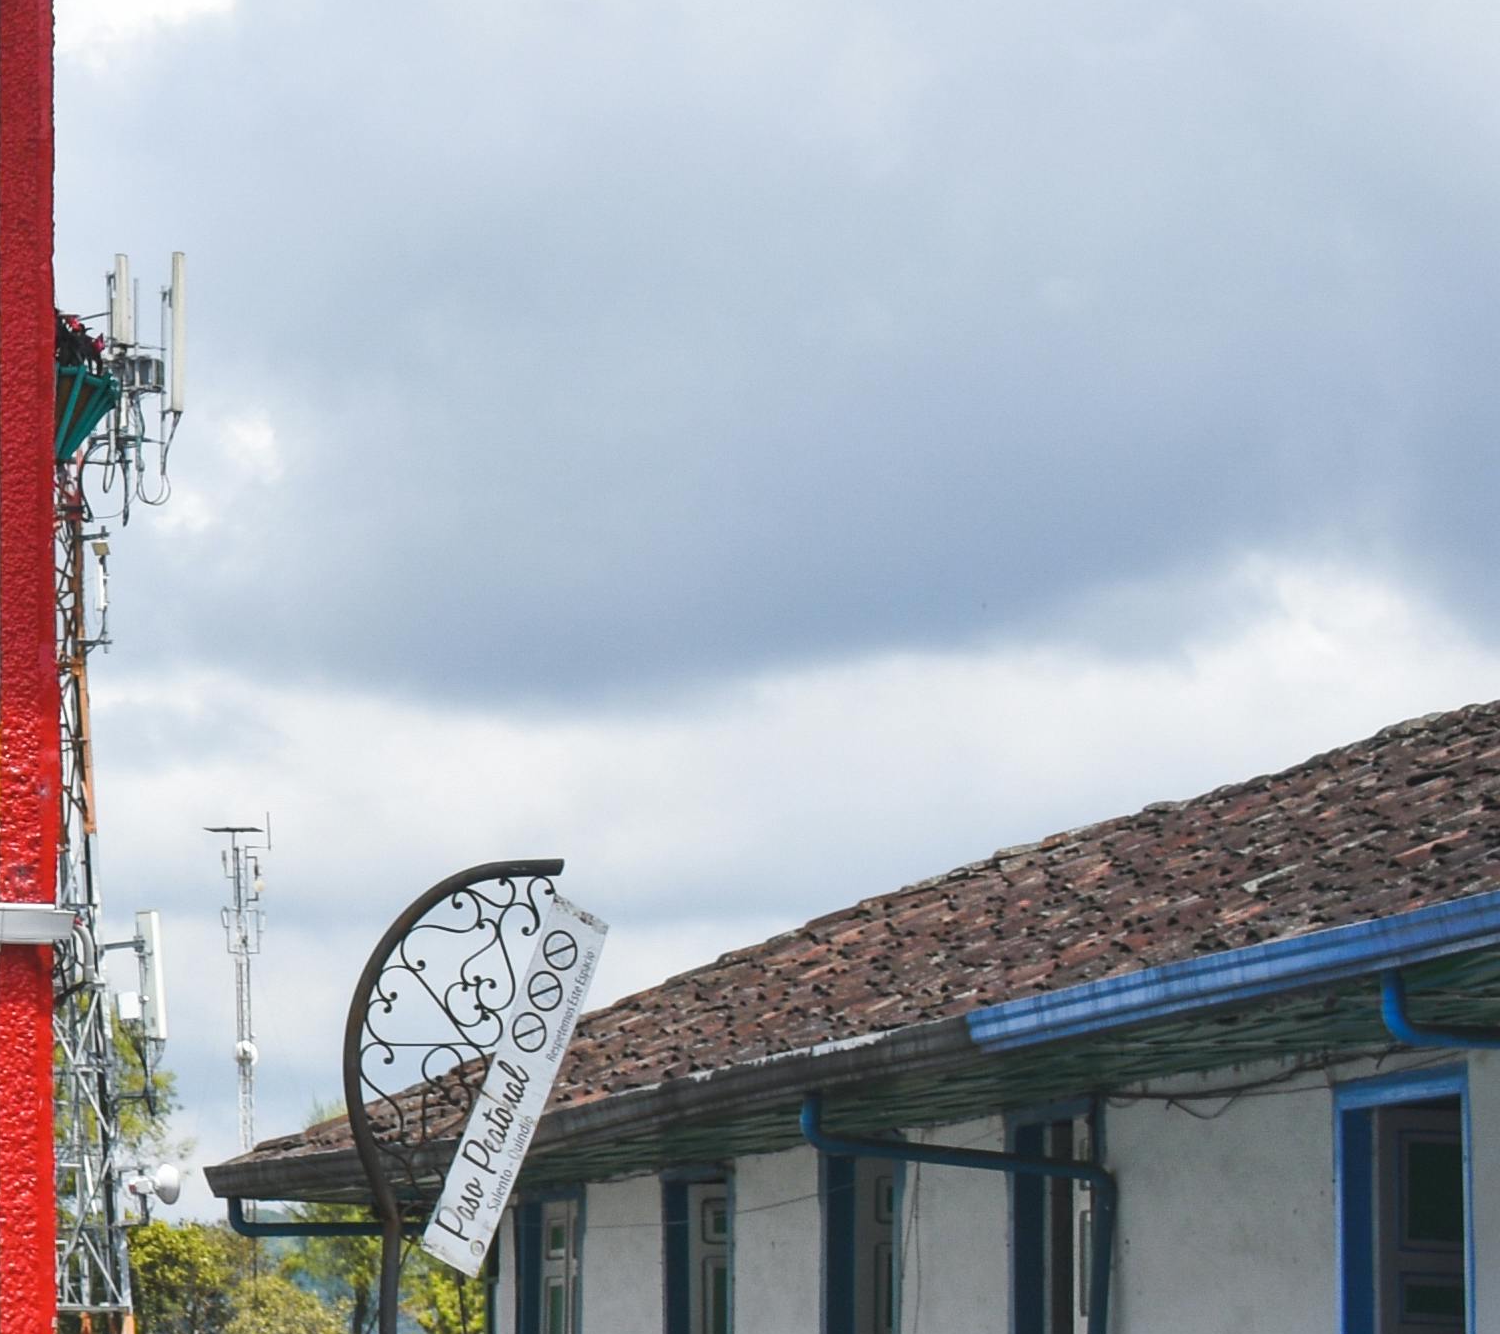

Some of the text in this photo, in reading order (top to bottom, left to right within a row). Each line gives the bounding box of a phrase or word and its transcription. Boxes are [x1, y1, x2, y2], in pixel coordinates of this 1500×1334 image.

[567, 985, 584, 1008] Este
[435, 1176, 485, 1242] Paso
[486, 1169, 514, 1213] Salento
